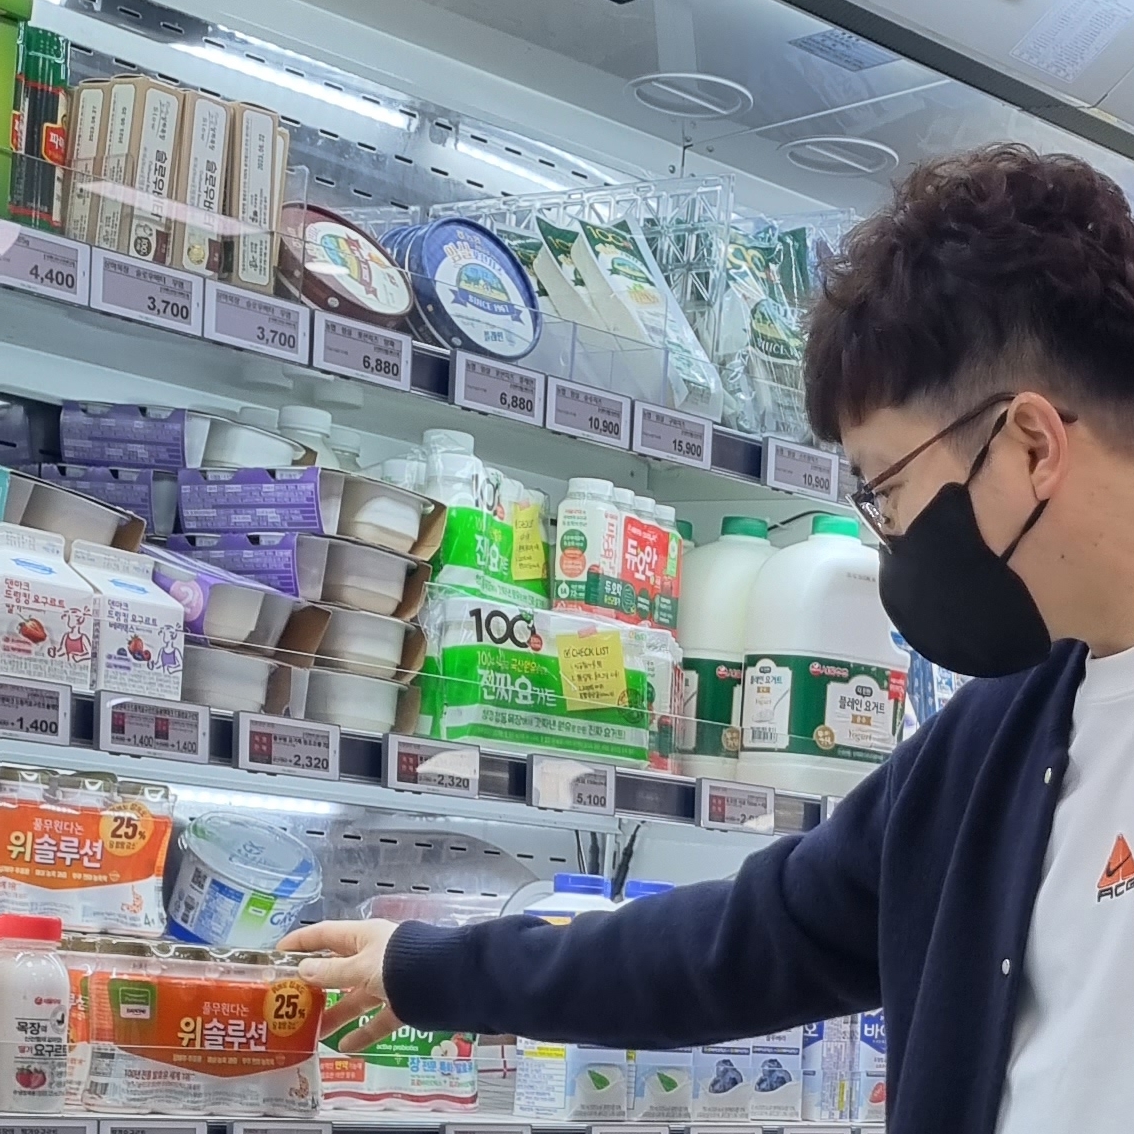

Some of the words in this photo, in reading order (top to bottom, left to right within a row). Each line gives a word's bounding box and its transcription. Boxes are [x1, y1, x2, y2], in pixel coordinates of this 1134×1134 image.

[29, 264, 75, 289] 4,400
[147, 296, 189, 320] 3,700
[256, 325, 296, 350] 3,700
[363, 354, 399, 377] 6,880
[500, 391, 533, 413] 6,880
[588, 415, 620, 436] 10,900
[672, 438, 702, 459] 15,900
[802, 472, 830, 491] 10,900
[5, 576, 31, 592] 덴마크
[5, 588, 31, 604] 드링킹
[32, 593, 66, 609] 요구르트
[107, 598, 129, 612] 덴마크
[107, 609, 132, 623] 드링킹
[133, 613, 158, 627] 요구르트
[572, 647, 594, 658] CHECK
[595, 646, 609, 656] LIST
[839, 695, 863, 711] 플레인
[864, 701, 885, 714] 요거트
[19, 716, 58, 734] 1,400
[132, 732, 154, 748] 1,400
[176, 737, 197, 753] 1,400
[293, 753, 330, 770] 2,320
[437, 773, 470, 788] 2,320
[577, 792, 607, 807] 5,100
[33, 818, 84, 835] 풀무원다논
[7, 831, 104, 868] 위솔루션
[202, 1001, 250, 1018] 풀무원다논
[177, 1017, 267, 1051] 위솔루션
